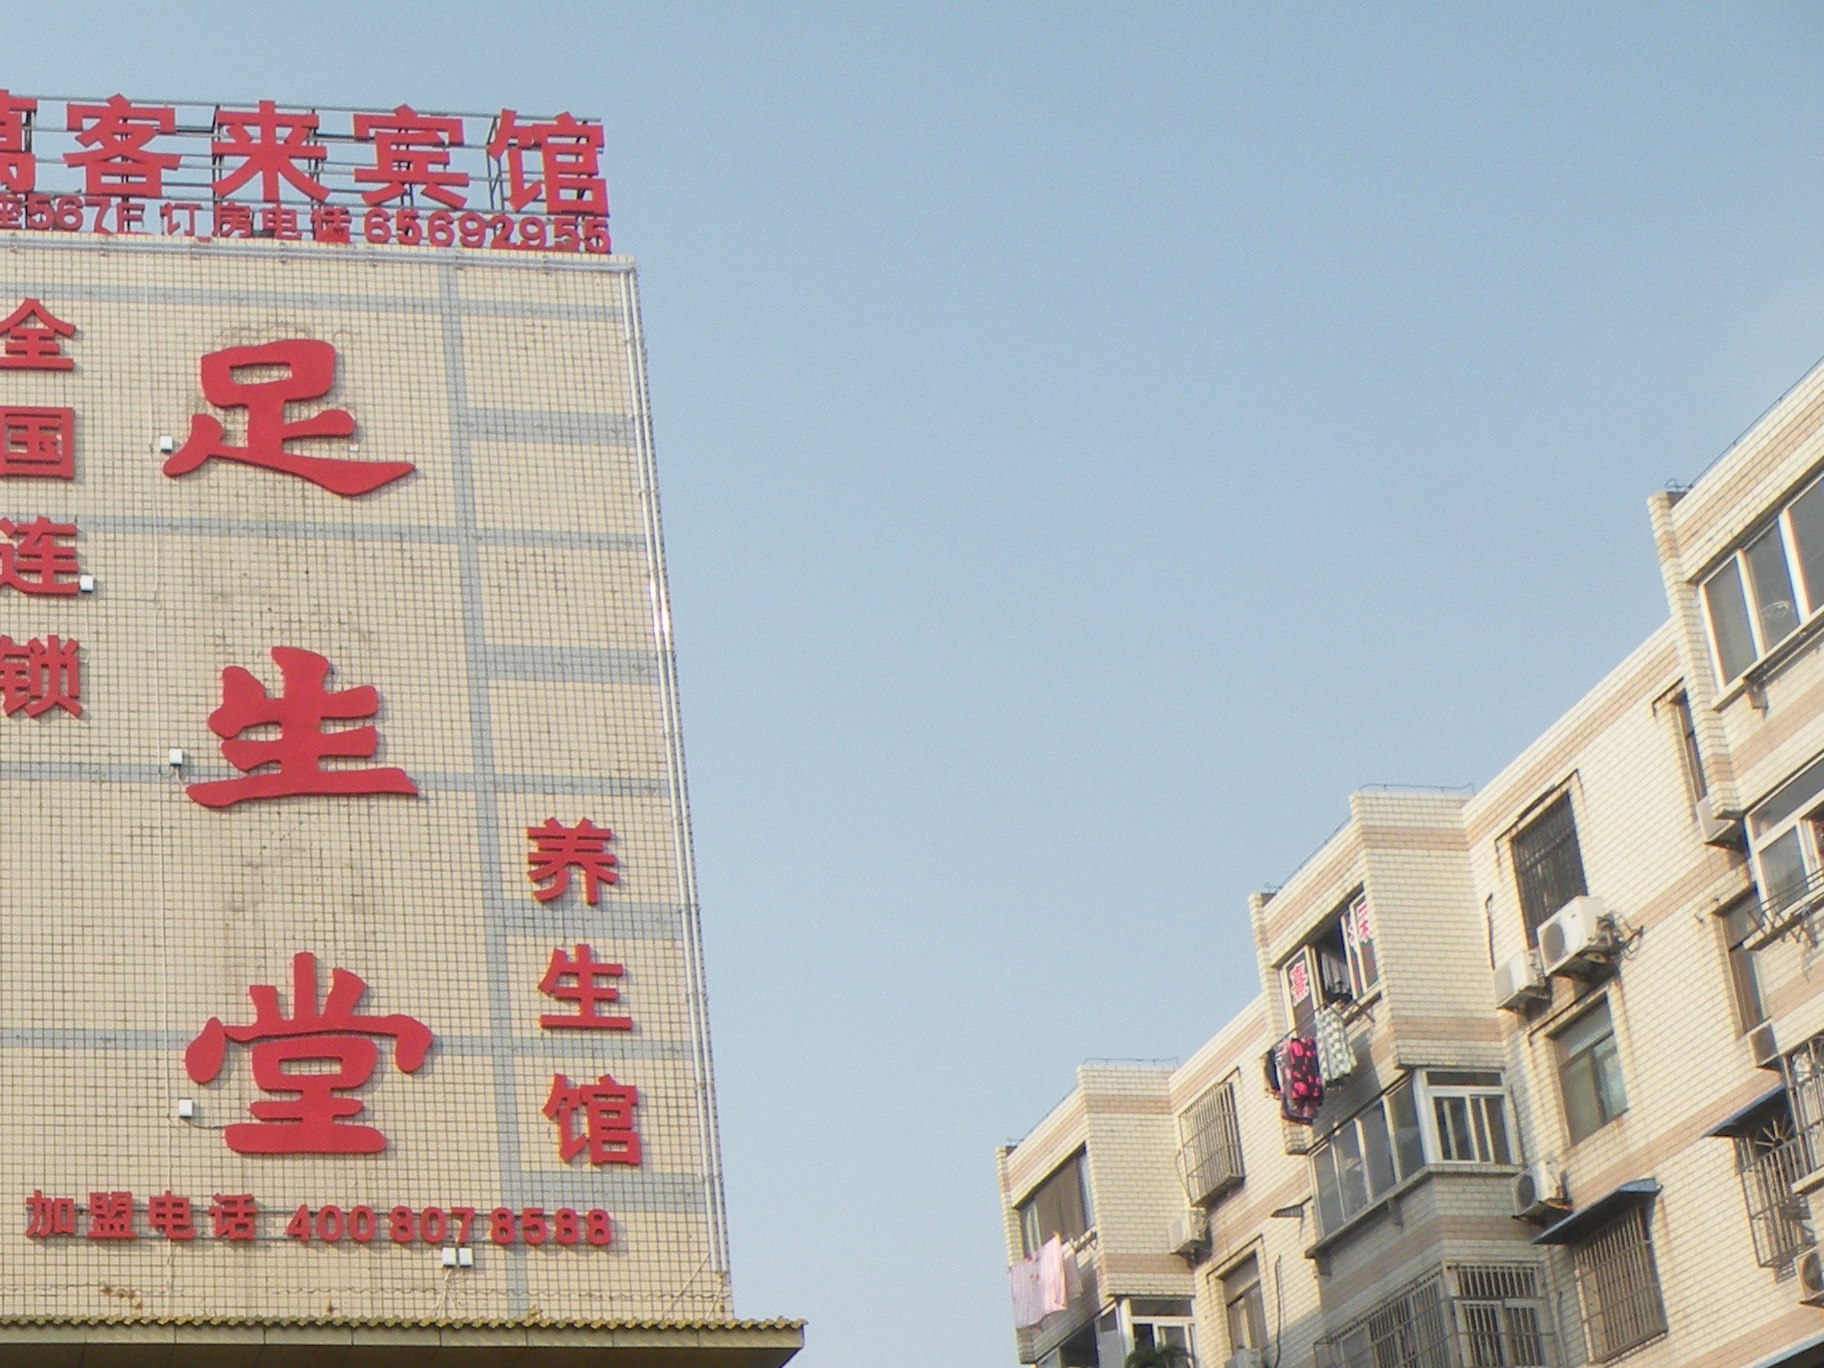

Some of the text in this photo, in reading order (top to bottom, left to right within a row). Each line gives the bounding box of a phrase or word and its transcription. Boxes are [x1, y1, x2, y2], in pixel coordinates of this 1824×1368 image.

[162, 339, 433, 1154] 足生堂
[527, 817, 641, 1166] 养生馆
[26, 1189, 259, 1242] 加盟电话
